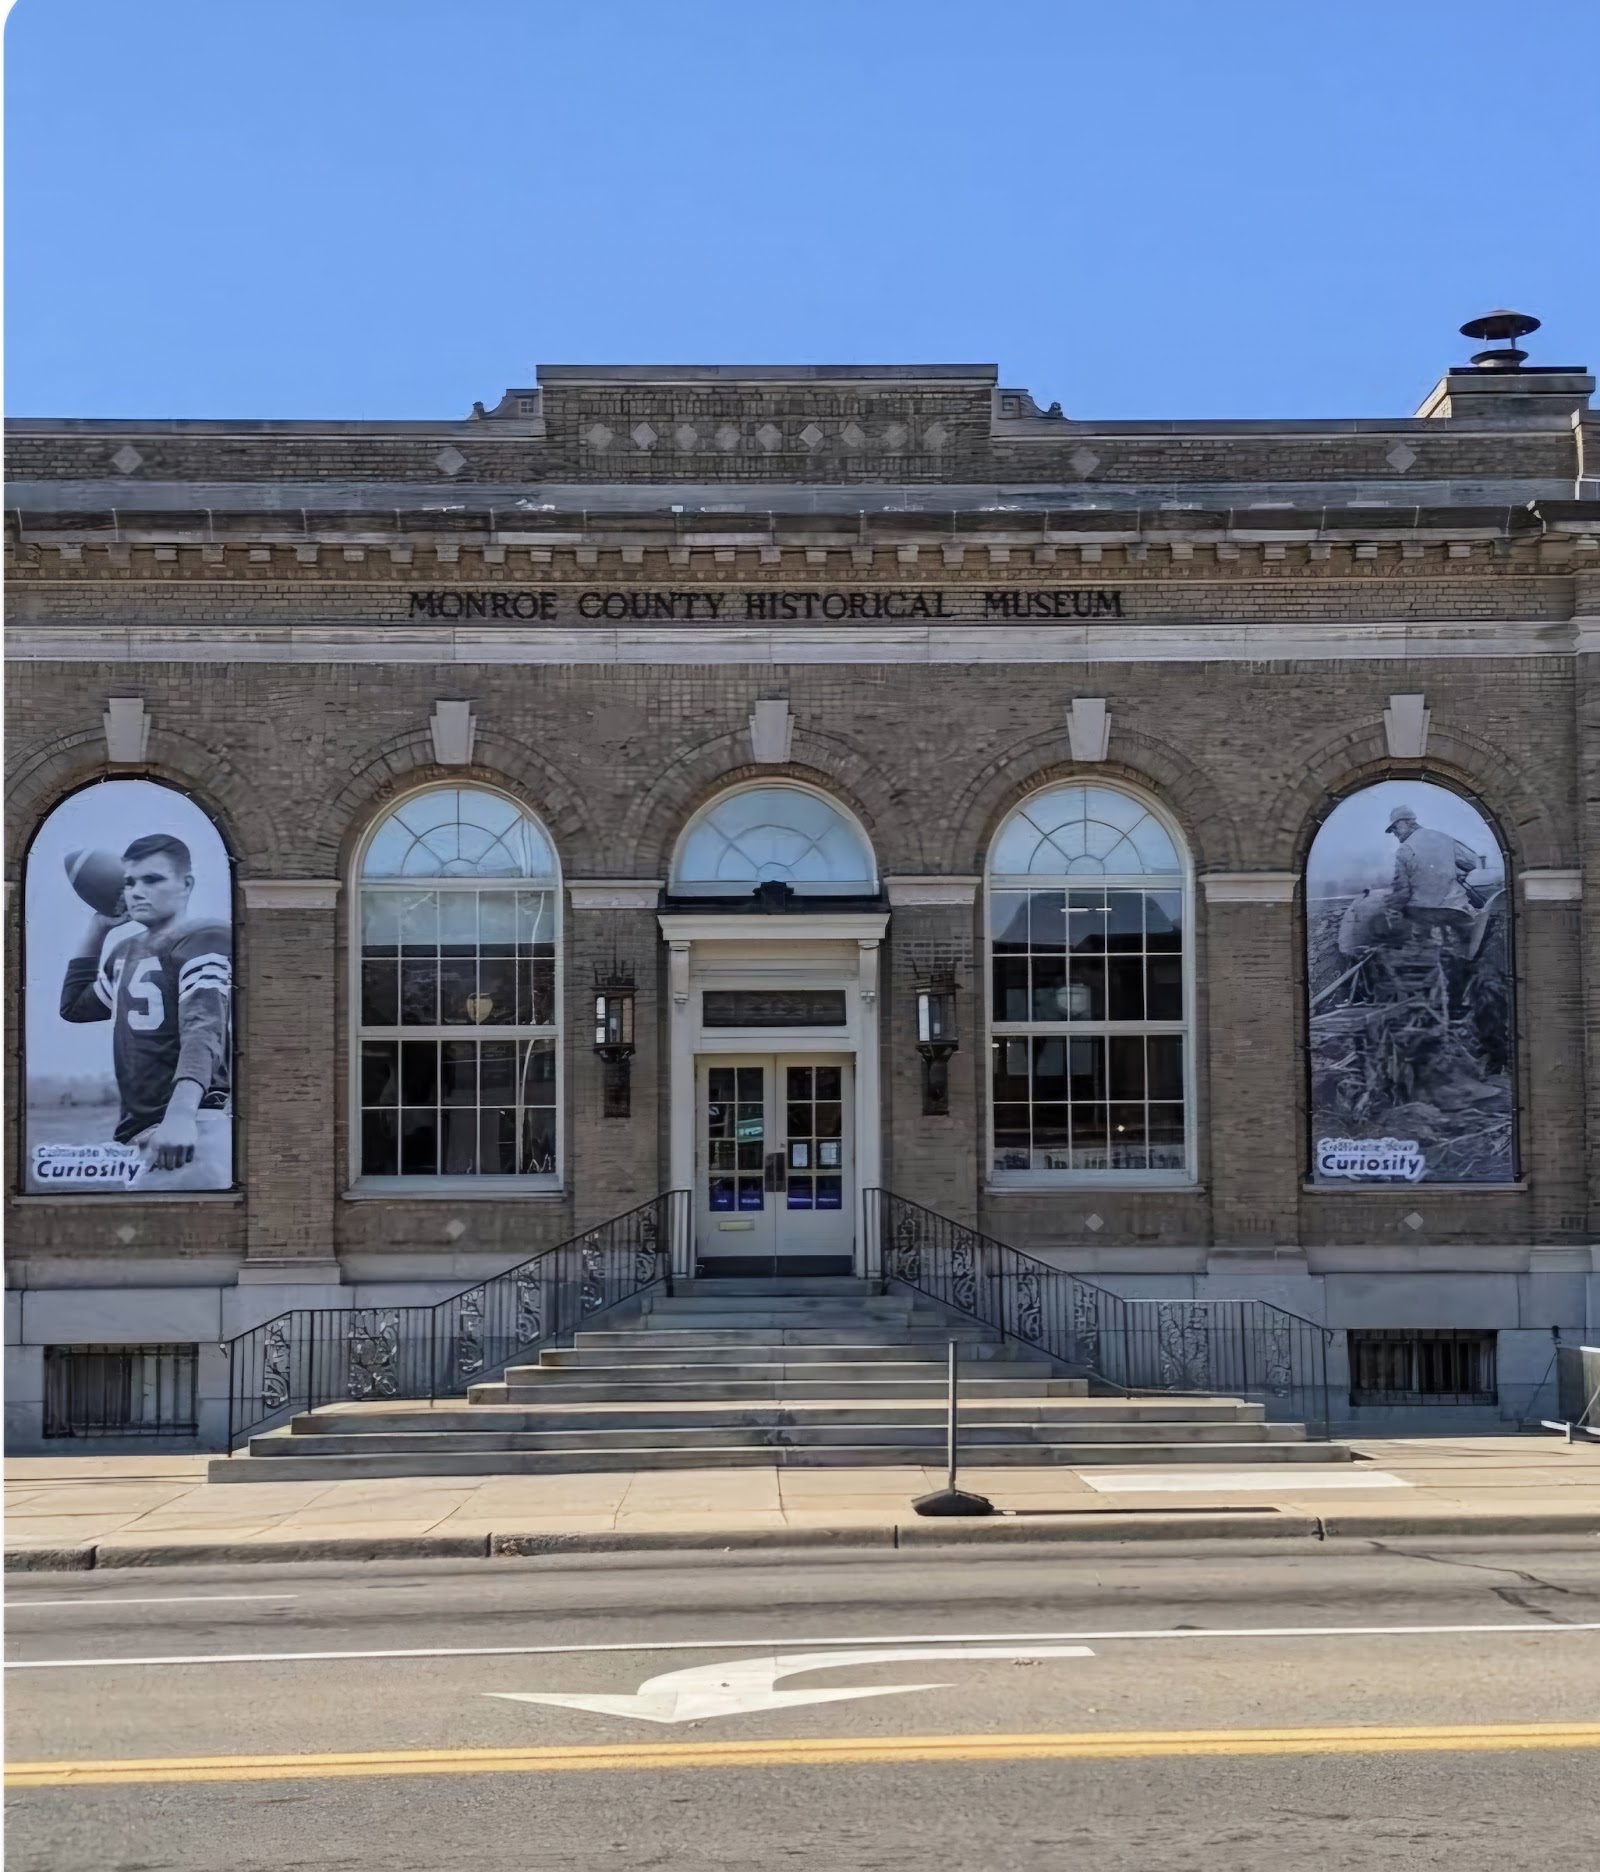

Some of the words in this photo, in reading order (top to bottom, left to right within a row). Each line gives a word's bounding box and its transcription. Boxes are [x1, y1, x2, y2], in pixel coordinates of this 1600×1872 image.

[408, 591, 558, 620] MONROE
[578, 591, 725, 619] COUNTY
[745, 591, 956, 619] HISTORICAL
[984, 590, 1125, 618] MUSEUM
[37, 1160, 140, 1181] Curiosity
[1322, 1154, 1420, 1174] Curiosity
